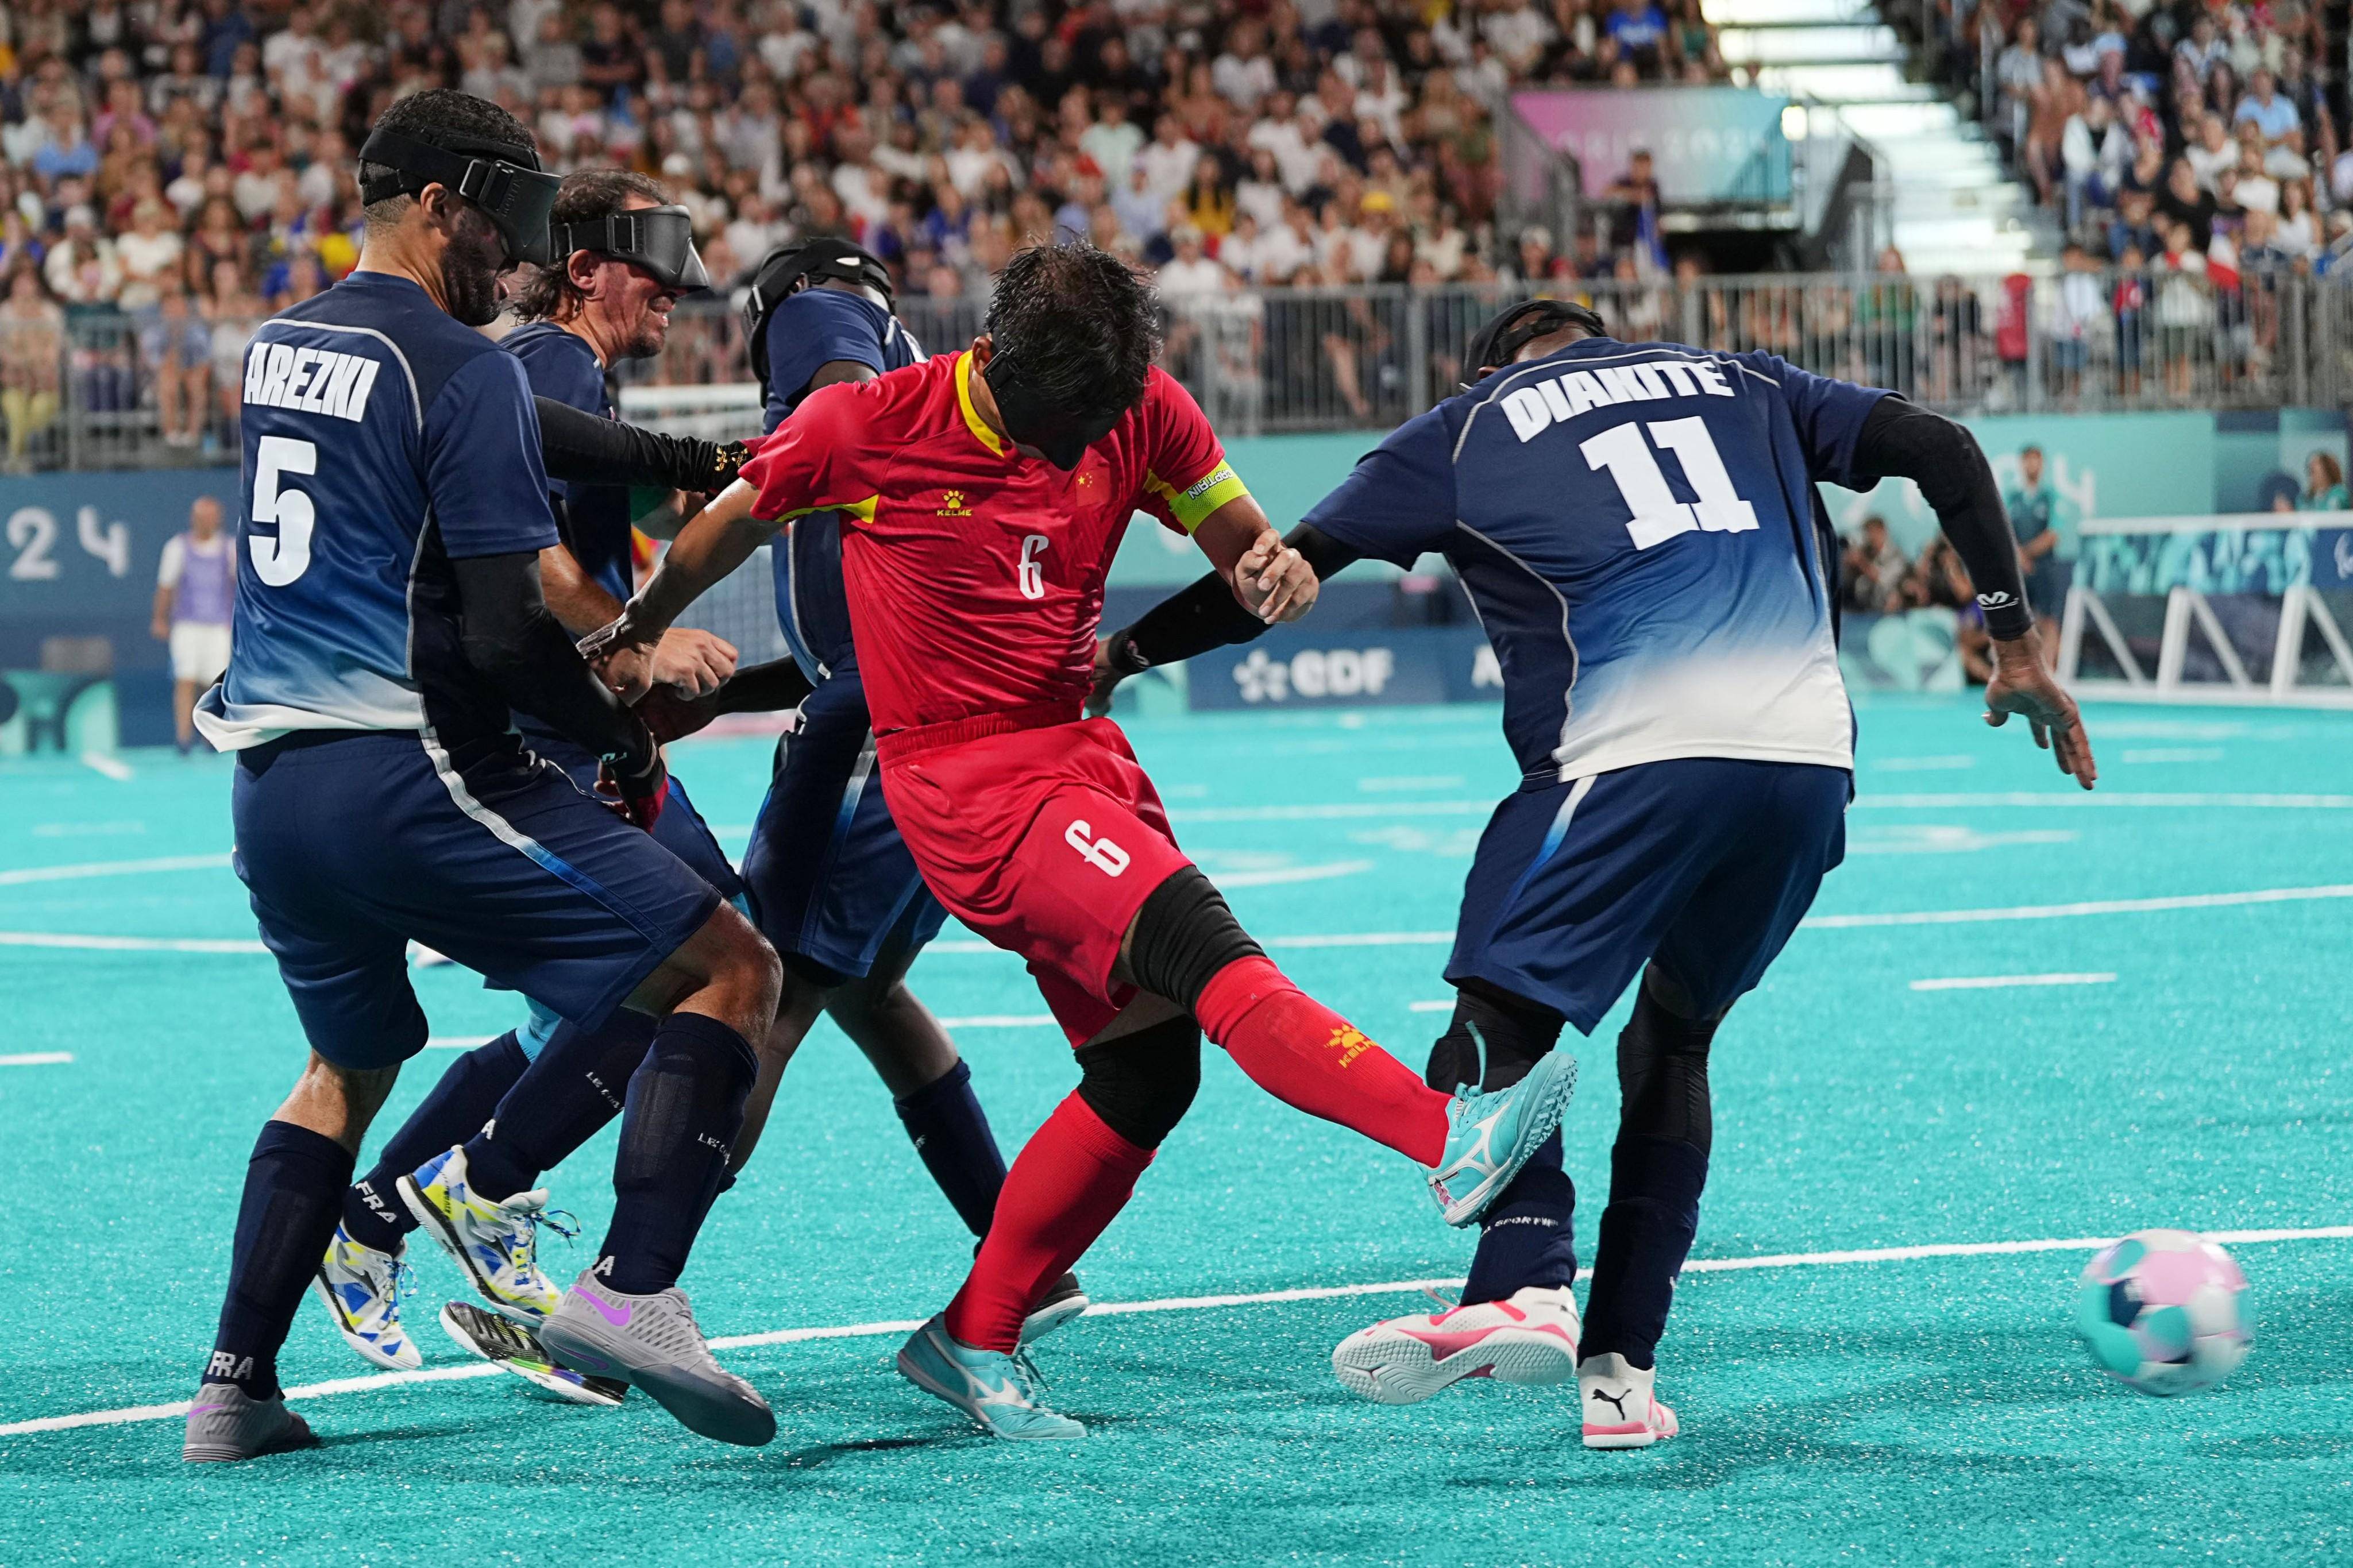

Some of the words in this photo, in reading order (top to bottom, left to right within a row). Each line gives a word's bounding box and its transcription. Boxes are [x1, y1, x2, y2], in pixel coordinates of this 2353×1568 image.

[244, 343, 380, 423] AREZKI
[1500, 361, 1735, 443] DIAKITE
[249, 435, 317, 587] 5
[1187, 469, 1233, 500] CAPTAIN
[1579, 416, 1760, 550] 11
[1017, 535, 1050, 600] 6
[1064, 820, 1131, 877] 6
[356, 1181, 397, 1223] FRA
[207, 1350, 253, 1379] FRA
